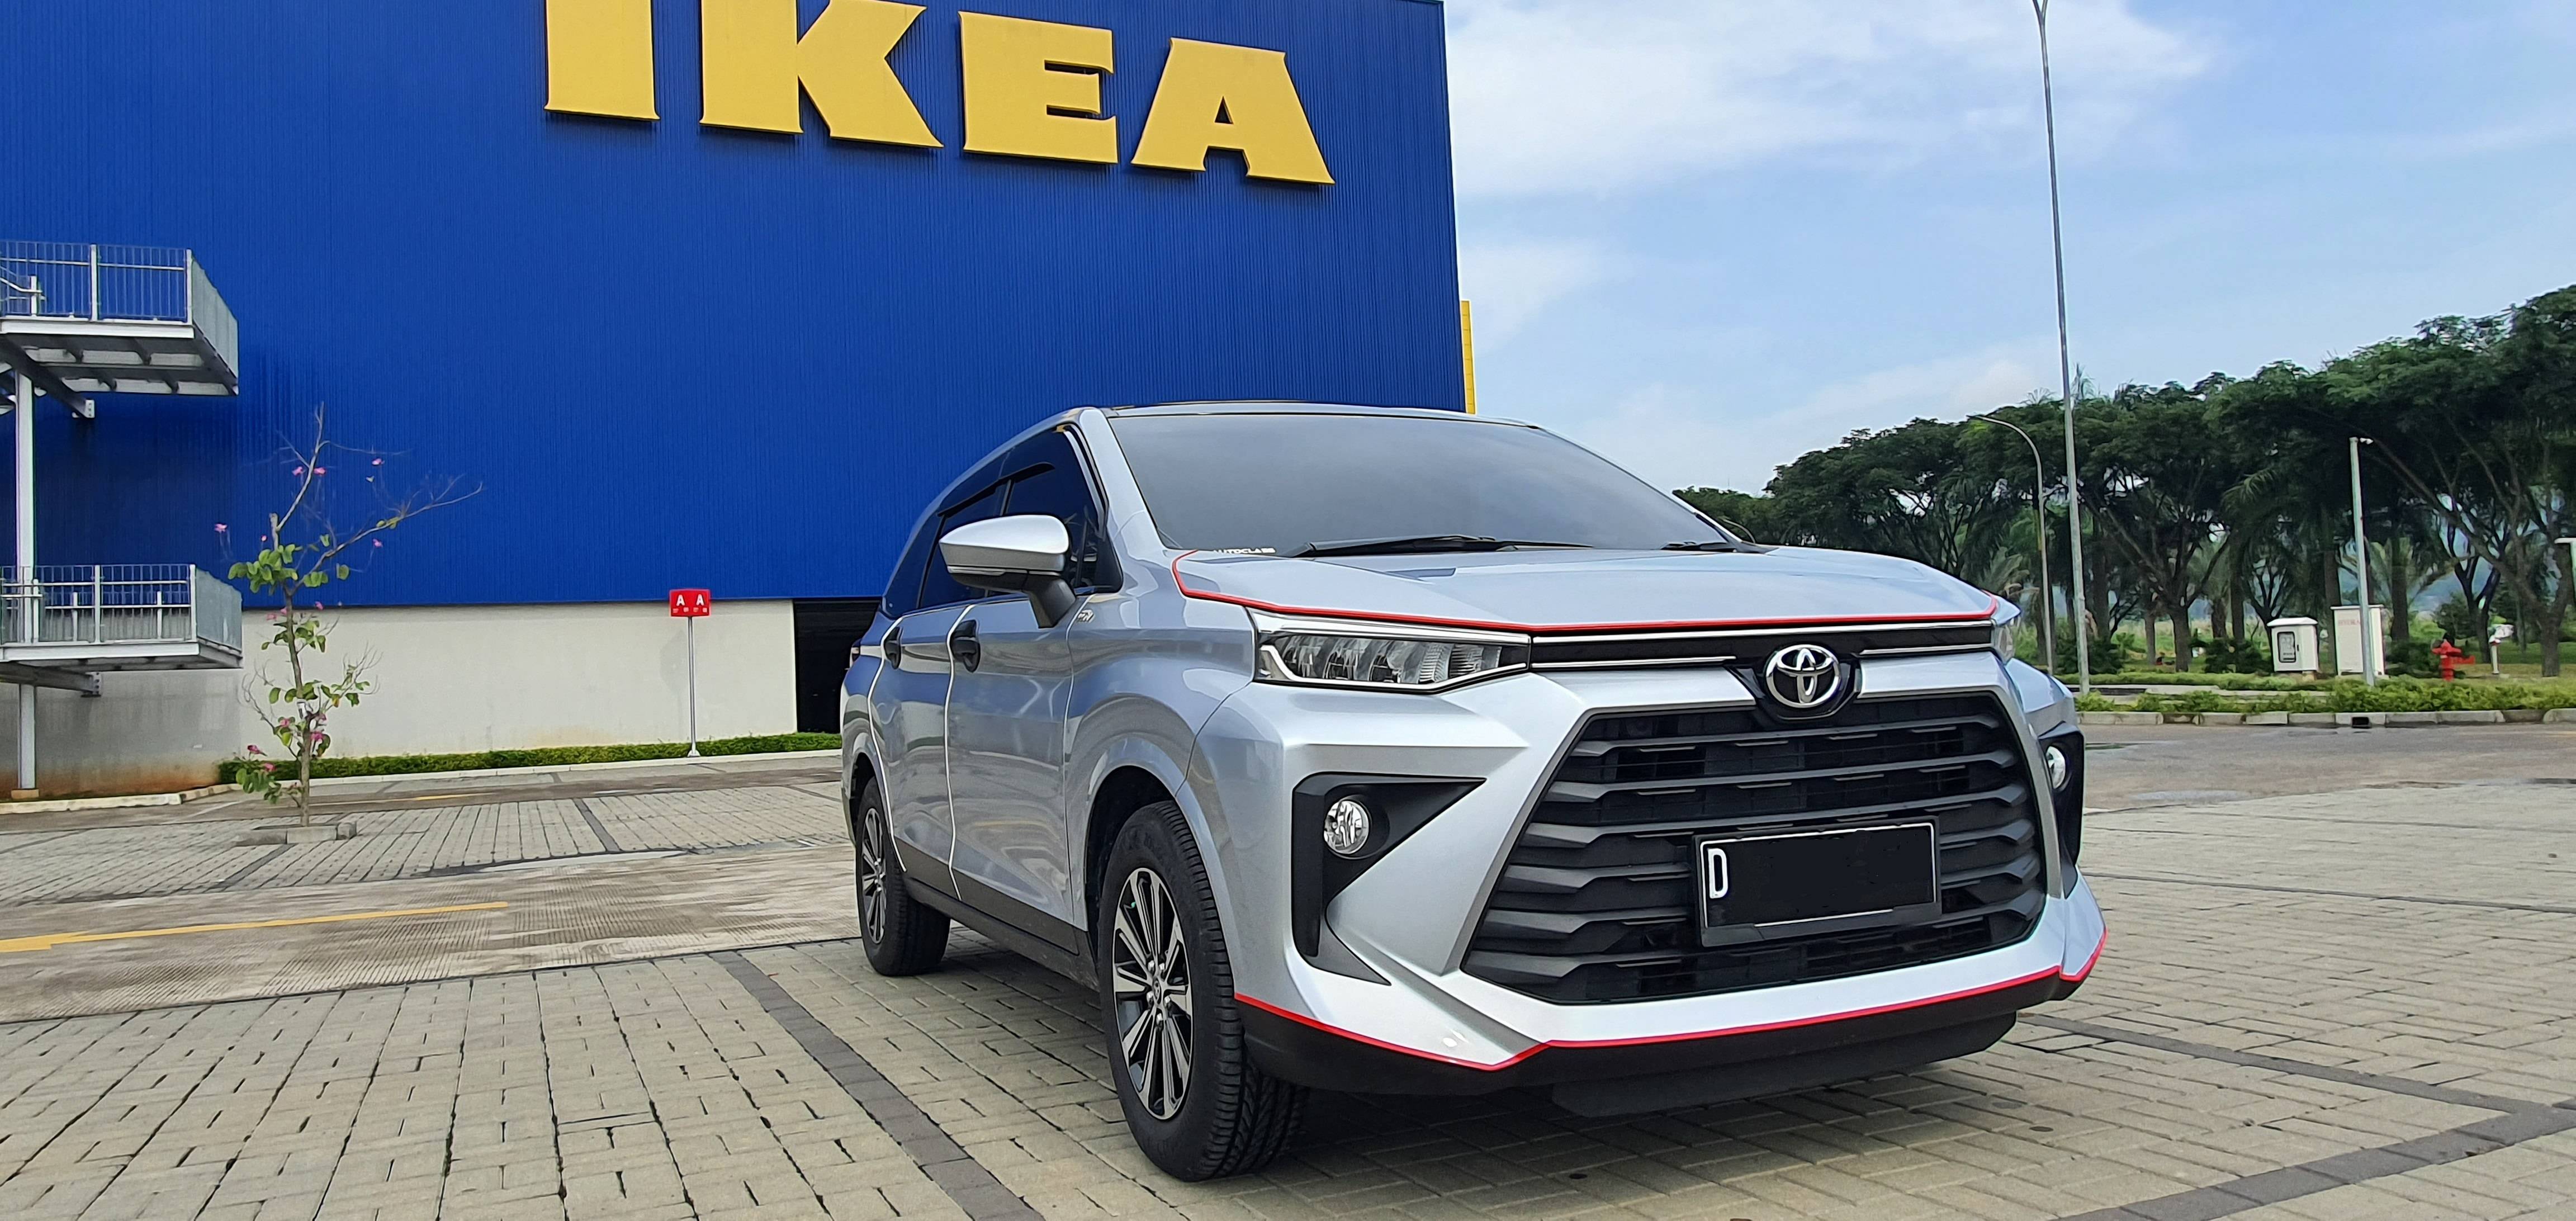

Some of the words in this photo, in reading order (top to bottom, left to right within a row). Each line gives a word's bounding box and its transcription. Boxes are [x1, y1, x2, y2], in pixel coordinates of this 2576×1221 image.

[544, 0, 1336, 184] IKEA
[676, 594, 685, 606] A
[696, 594, 704, 605] A
[1707, 848, 1728, 899] D
